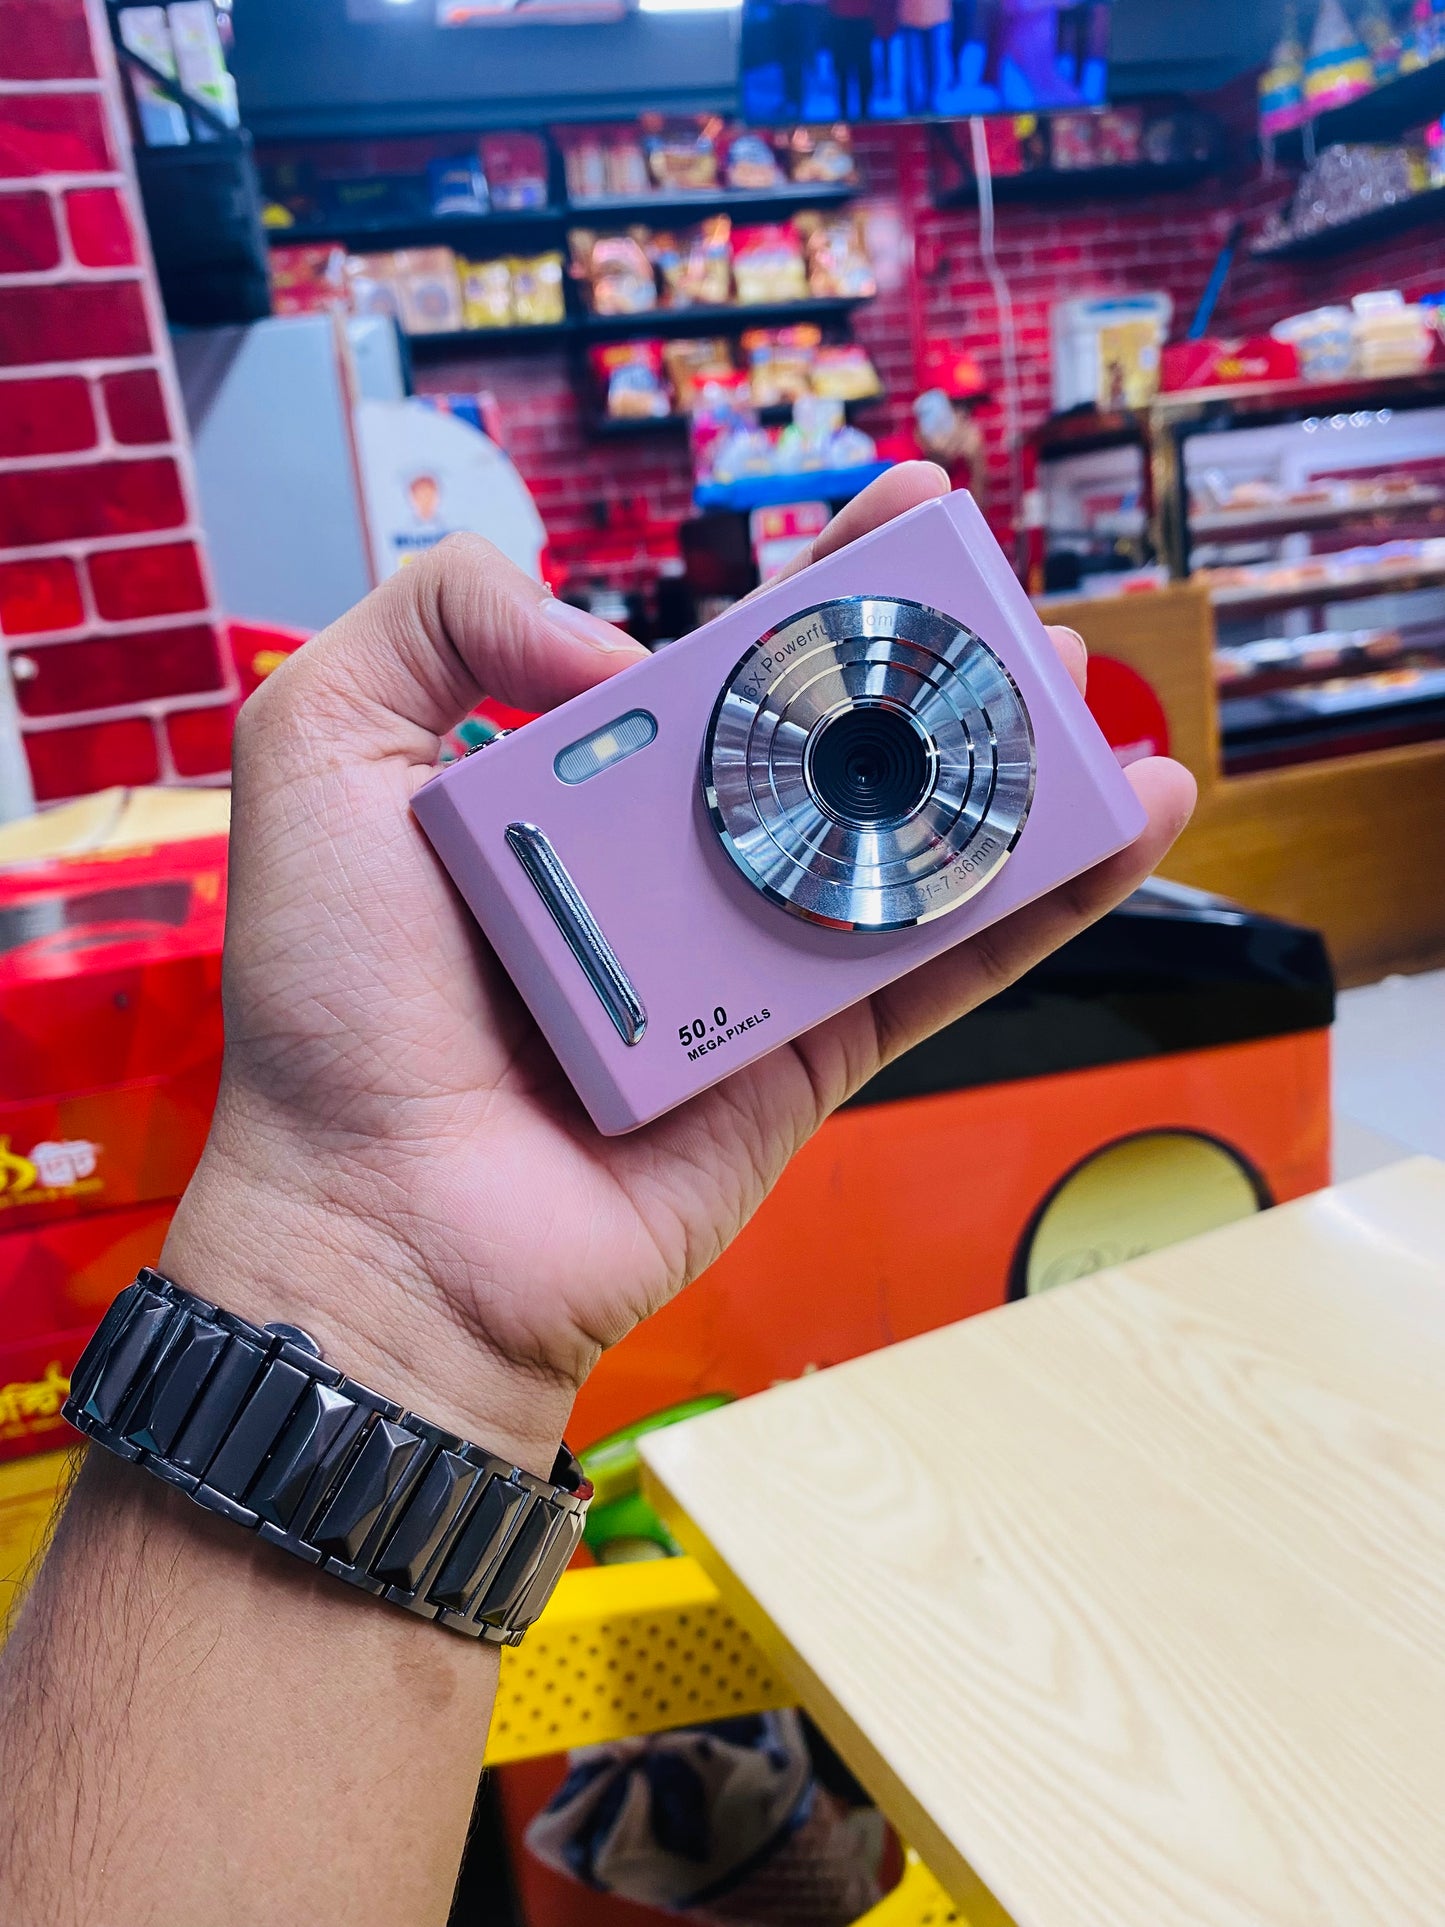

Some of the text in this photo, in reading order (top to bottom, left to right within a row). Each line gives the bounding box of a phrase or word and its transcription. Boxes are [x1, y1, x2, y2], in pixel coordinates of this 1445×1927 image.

[738, 671, 766, 705] 16X
[678, 1006, 728, 1047] 50.0
[687, 1008, 771, 1062] MEGA PIXELS
